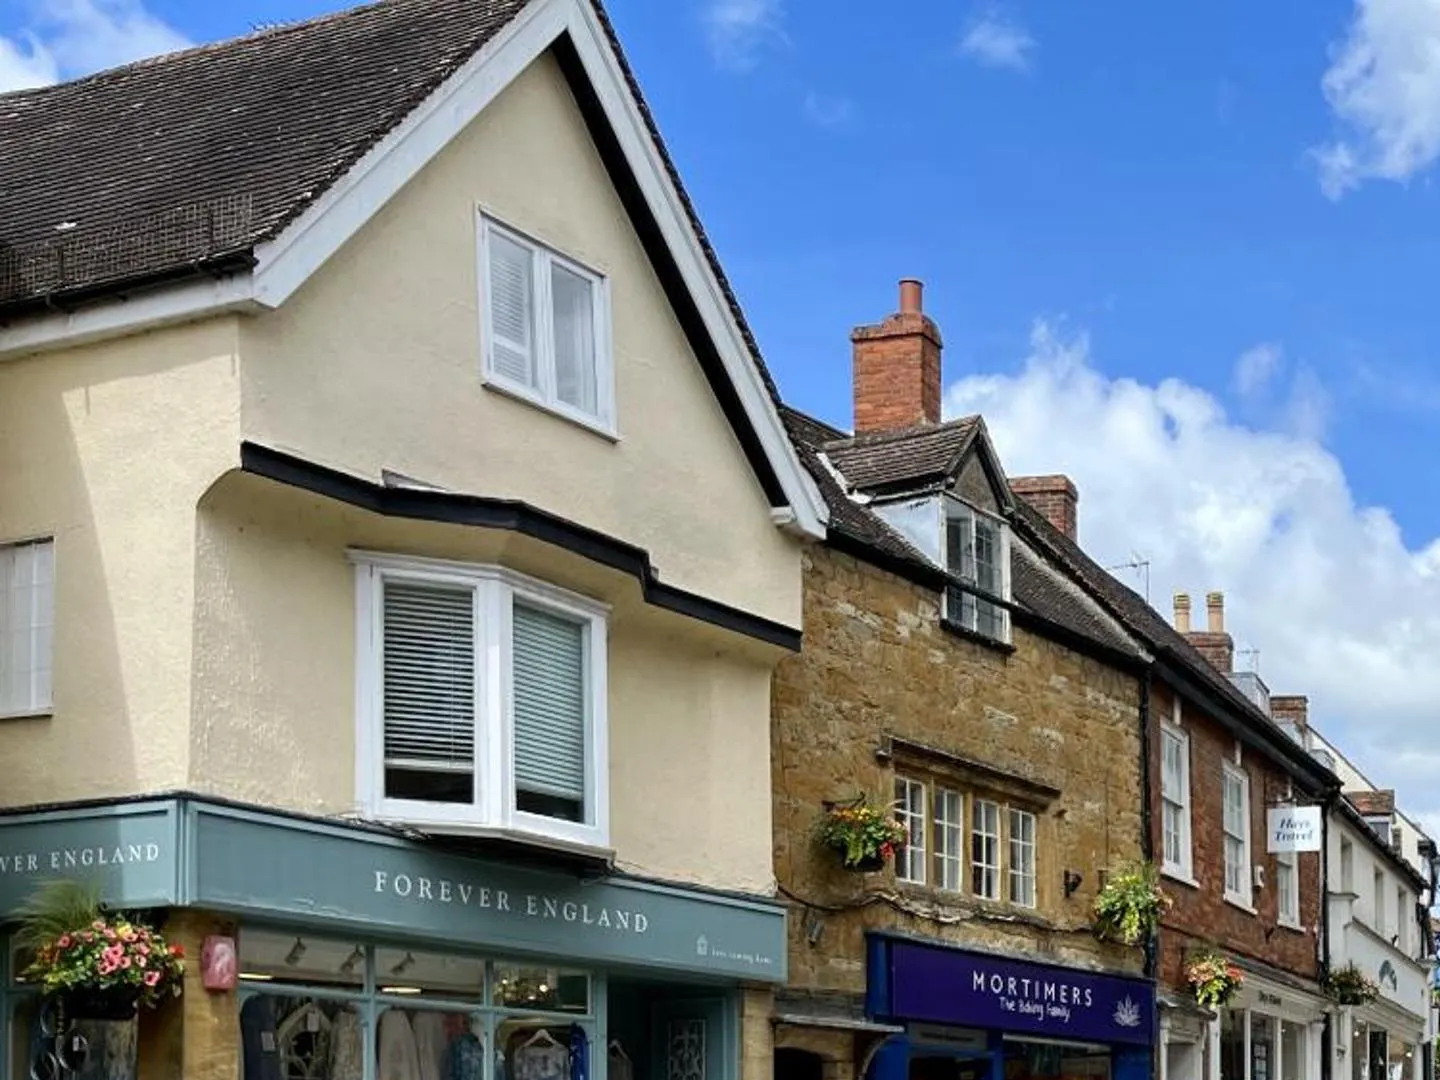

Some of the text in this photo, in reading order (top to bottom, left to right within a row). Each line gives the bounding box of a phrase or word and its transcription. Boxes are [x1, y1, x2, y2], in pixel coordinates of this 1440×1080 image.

[50, 843, 160, 869] ENGLAND
[374, 870, 649, 934] FOREVER ENGLAND
[972, 970, 1093, 1007] MORTIMERS
